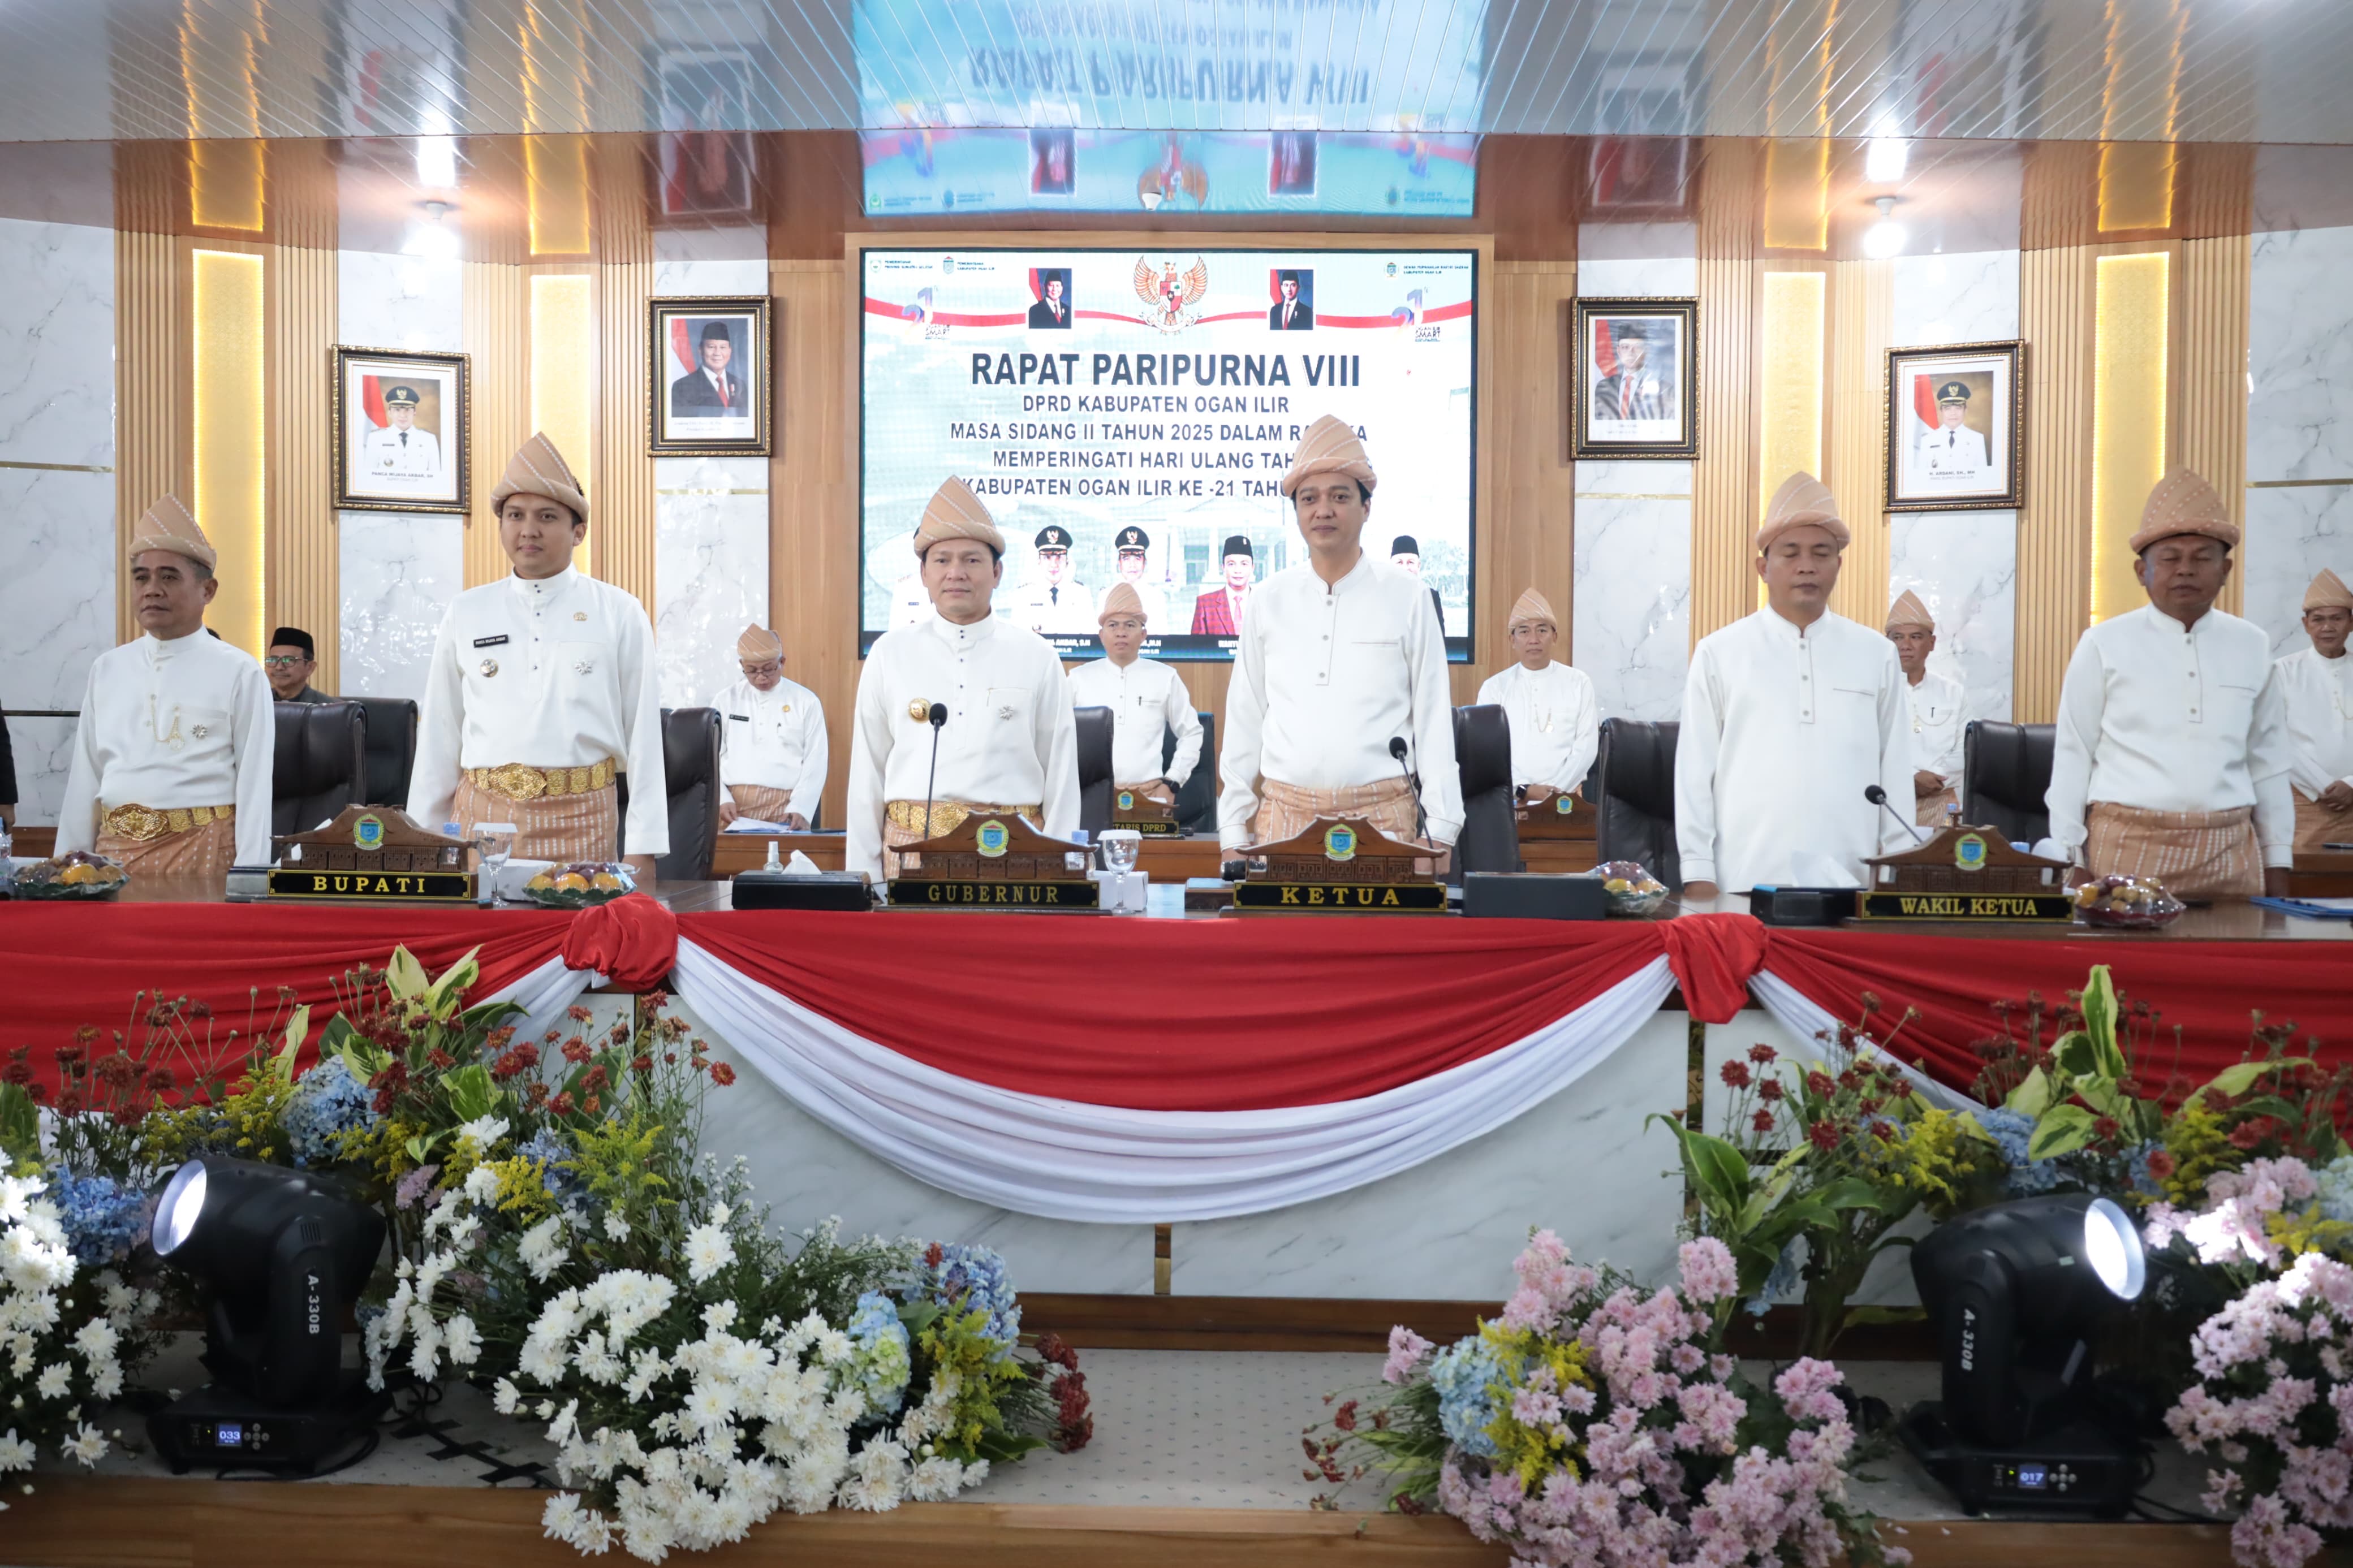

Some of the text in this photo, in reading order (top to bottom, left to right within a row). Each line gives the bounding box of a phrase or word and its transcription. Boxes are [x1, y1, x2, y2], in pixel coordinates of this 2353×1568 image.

[972, 353, 1359, 386] RAPAT PARIPURNA VIII
[1023, 395, 1288, 413] DPRD KABUPATEN OGAN ILIR
[951, 422, 1001, 439] MASA
[1009, 423, 1076, 440] SIDANG
[1084, 424, 1093, 439] II
[1102, 424, 1163, 440] TAHUN
[1171, 424, 1213, 440] 2025
[1221, 425, 1282, 440] DALAM
[994, 451, 1132, 468] MEMPERINGATI
[1141, 452, 1183, 468] HARI
[1191, 452, 1253, 468] ULANG
[1079, 479, 1130, 495] OGAN
[1138, 480, 1171, 495] ILIR
[1179, 480, 1202, 496] KE
[1209, 480, 1233, 496] -21
[1143, 823, 1167, 832] DPRD
[313, 876, 425, 893] BUPATI
[928, 885, 1058, 903] GUBERNUR
[1281, 887, 1400, 905] KETUA
[1900, 897, 2037, 915] WAKIL KETUA
[219, 1431, 240, 1440] 033
[2019, 1472, 2044, 1481] 017
